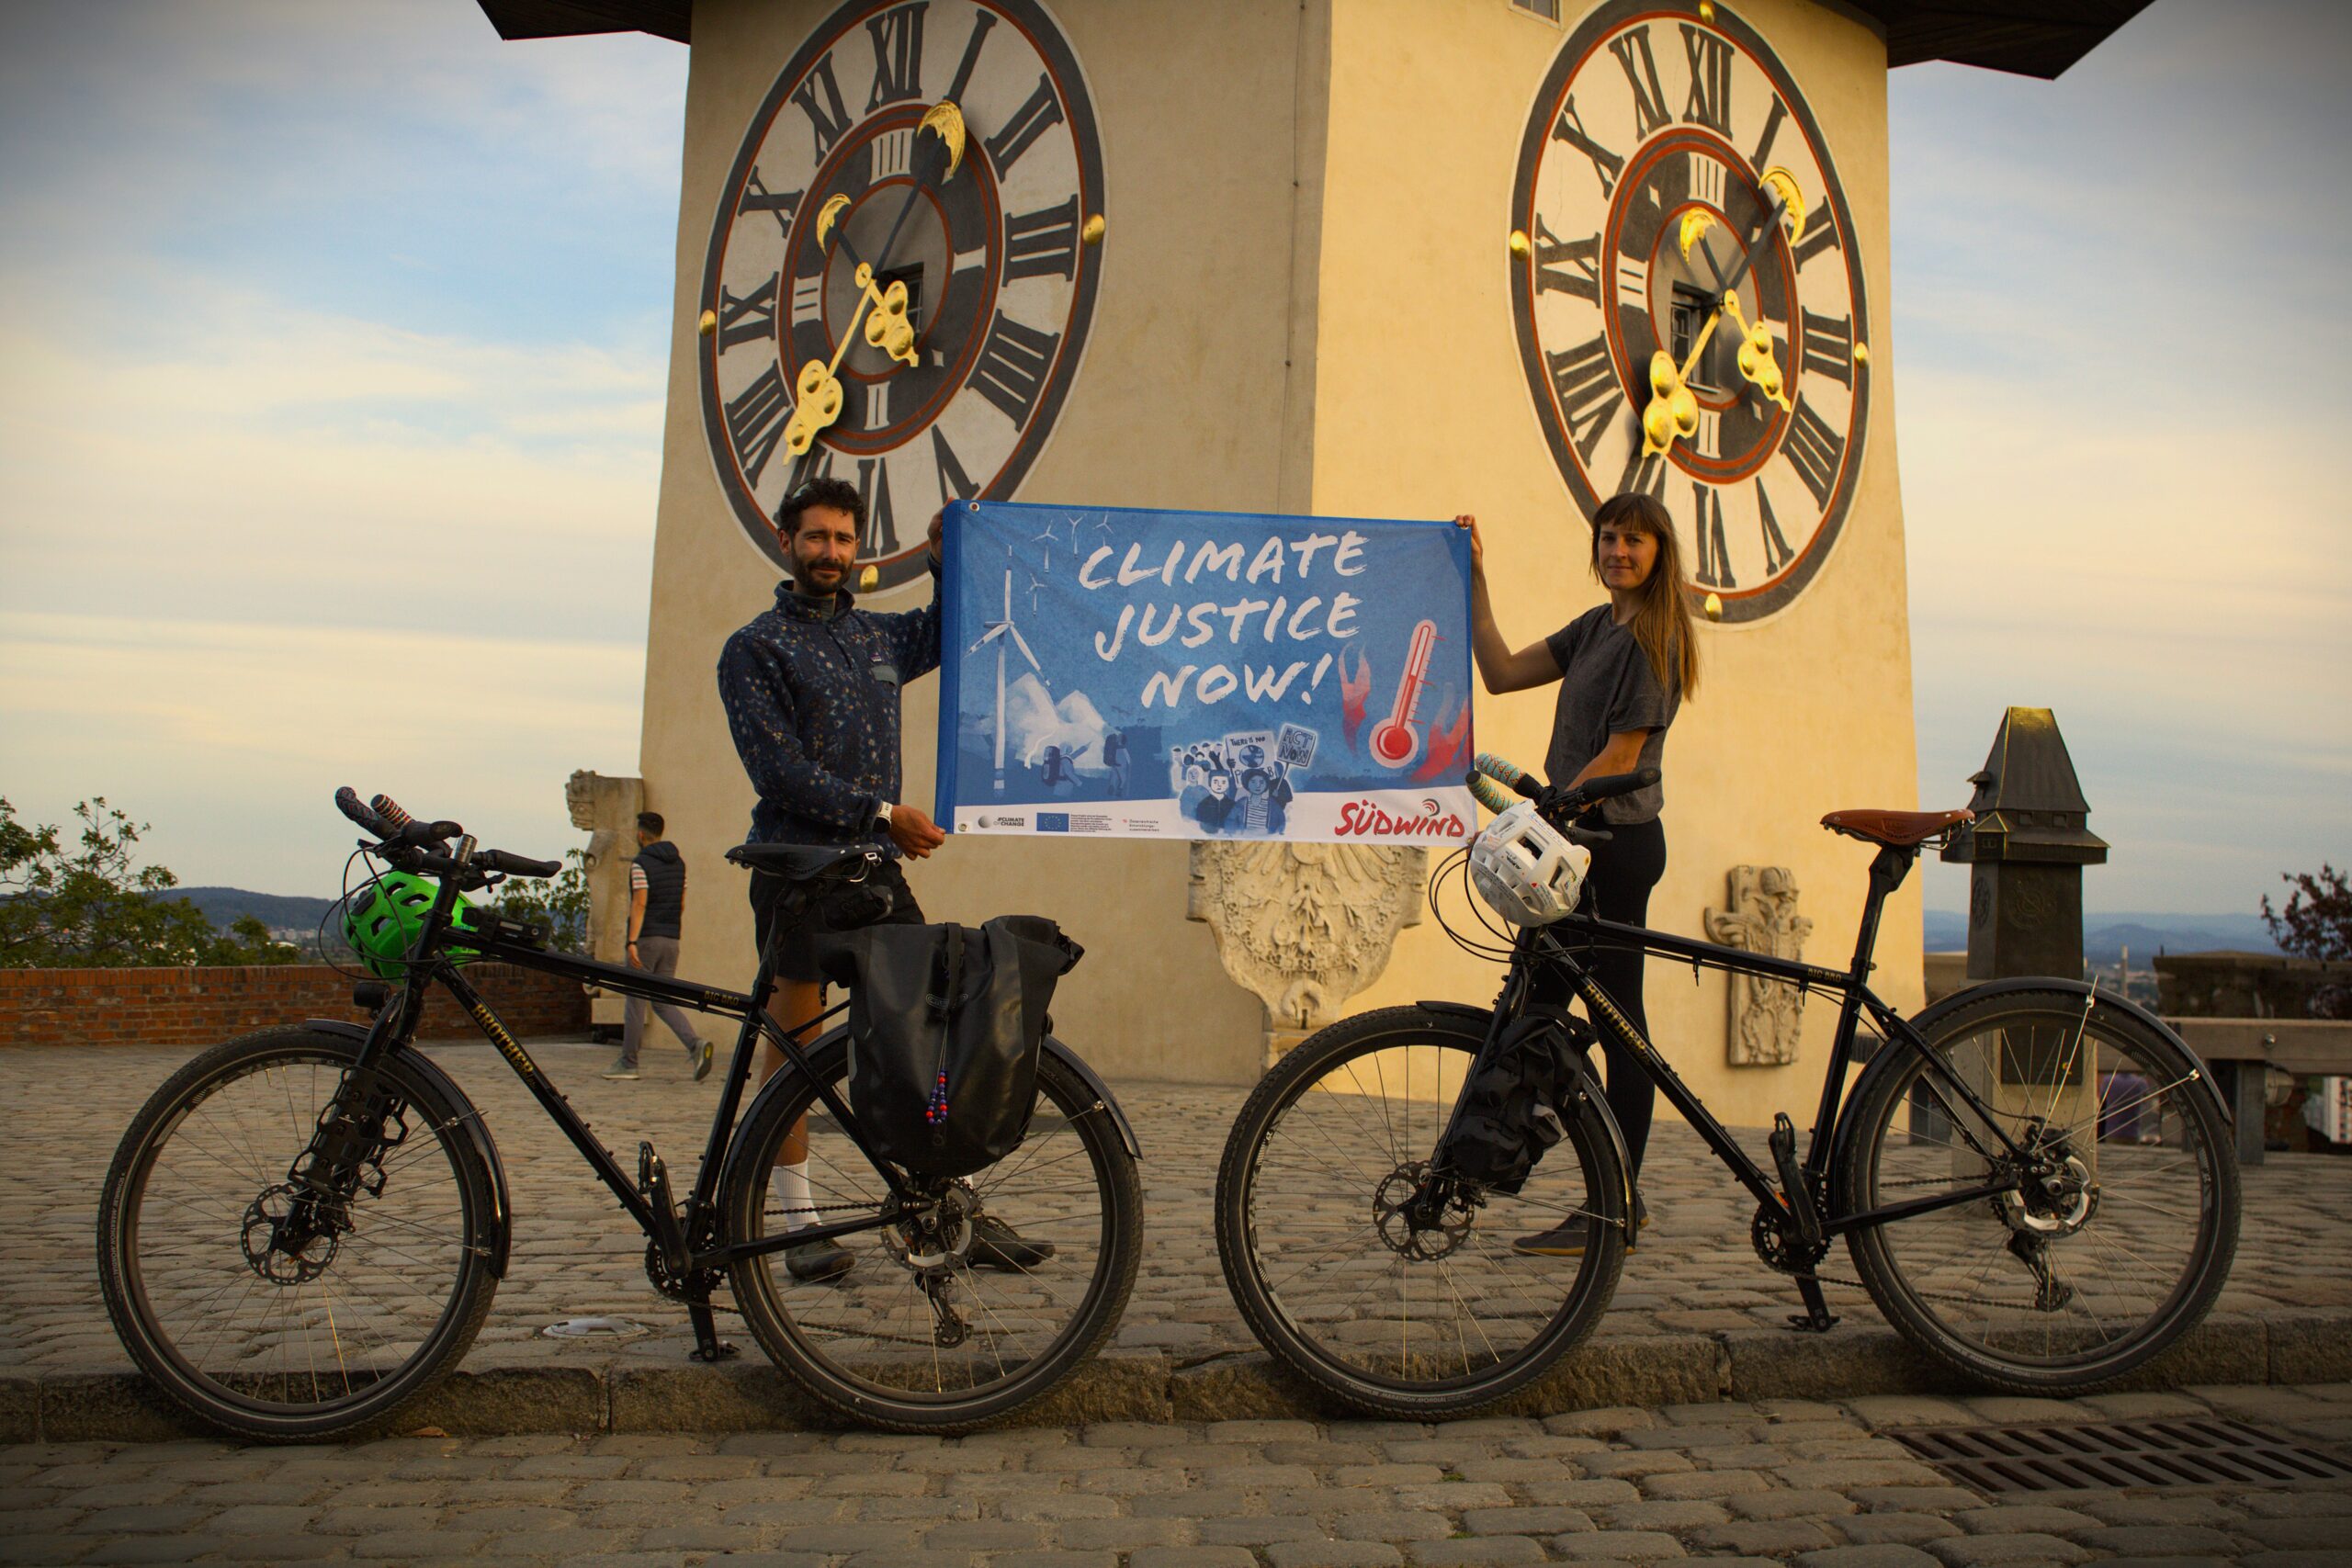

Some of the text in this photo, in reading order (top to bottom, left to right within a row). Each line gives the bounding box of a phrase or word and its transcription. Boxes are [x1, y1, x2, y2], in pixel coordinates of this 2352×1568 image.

[865, 2, 929, 116] XII
[943, 8, 998, 108] I
[1608, 24, 1673, 143] XI
[1679, 22, 1735, 142] XII
[790, 51, 853, 167] XI
[984, 72, 1064, 184] II
[1552, 92, 1625, 202] X
[1749, 91, 1789, 176] I
[737, 164, 805, 239] X
[1001, 194, 1078, 288] III
[1785, 195, 1840, 274] II
[1535, 212, 1601, 309] IX
[718, 271, 779, 355] IX
[1801, 305, 1852, 391] III
[964, 308, 1061, 434] IIII
[1545, 330, 1624, 469] VIII
[1779, 390, 1845, 513] IIII
[856, 457, 899, 559] VI
[1692, 481, 1736, 588] VI
[1756, 475, 1795, 577] V
[1078, 530, 1372, 591] CLIMATE
[1094, 592, 1363, 662] JUSTICE
[1141, 653, 1333, 708] NOW!
[1230, 737, 1248, 747] THERE
[1279, 746, 1309, 764] NOW
[1283, 728, 1313, 749] ACT
[1334, 799, 1464, 838] SÜDWIND
[471, 1002, 534, 1073] BROTHER
